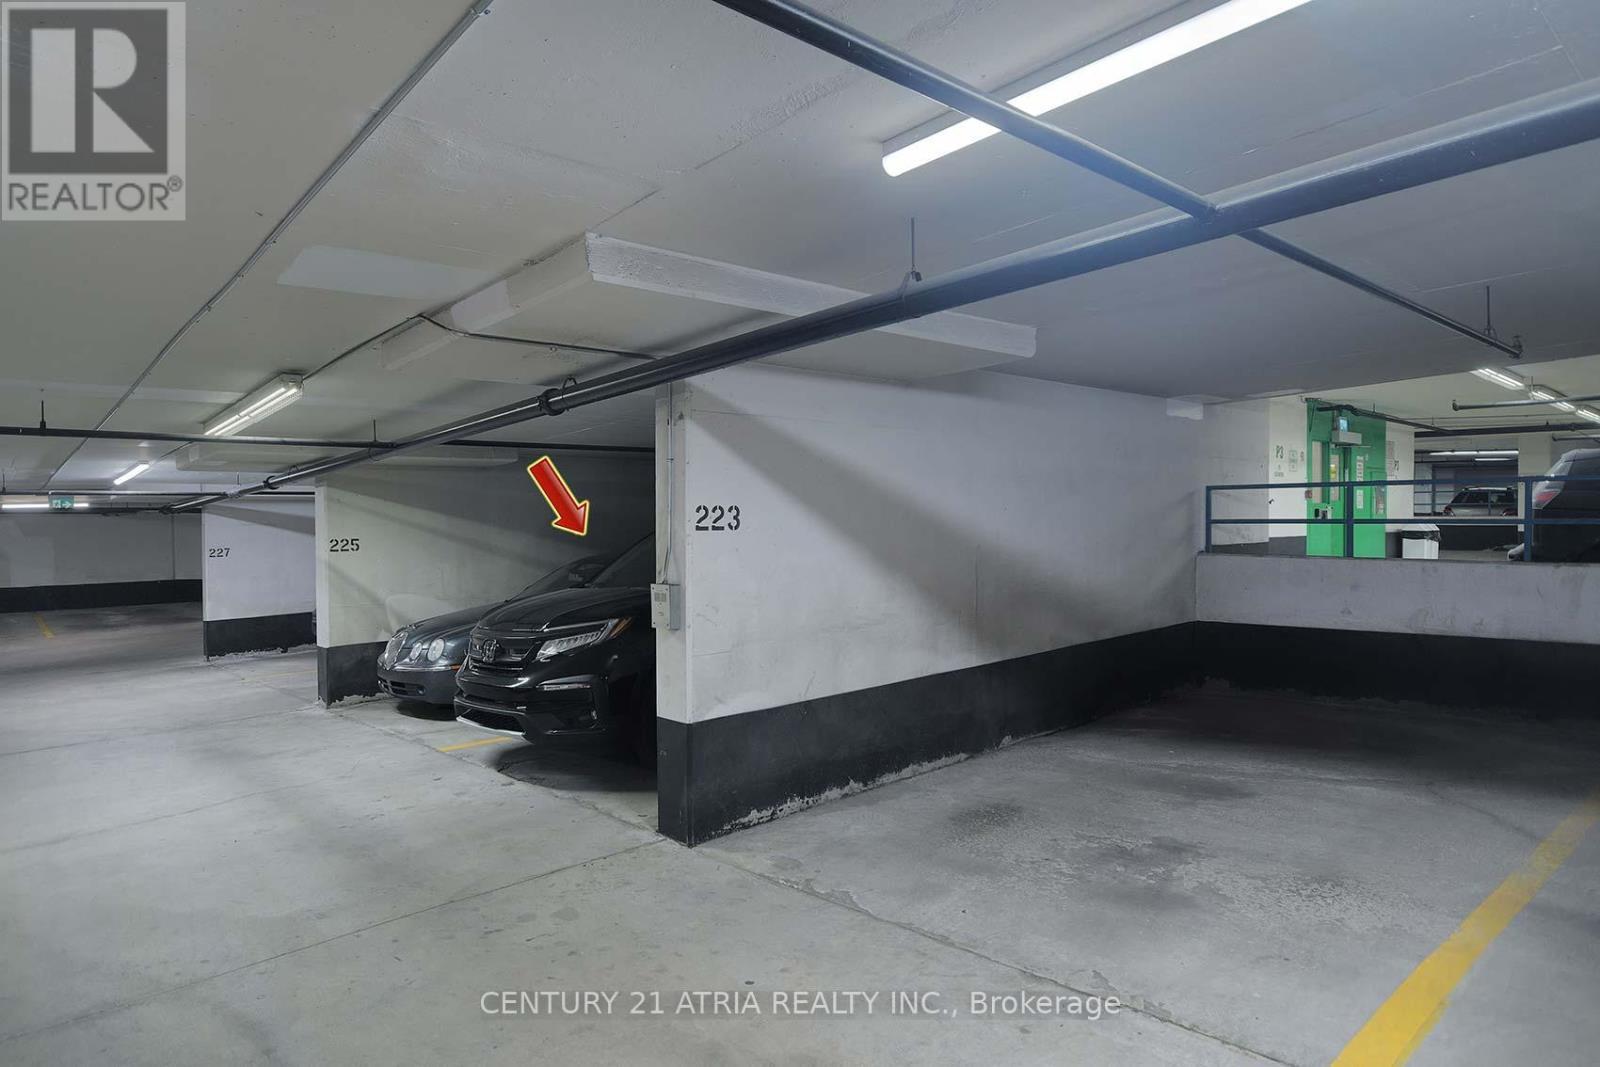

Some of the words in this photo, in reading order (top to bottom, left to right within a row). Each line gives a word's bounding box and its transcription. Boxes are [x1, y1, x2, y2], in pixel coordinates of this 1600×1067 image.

[695, 504, 741, 531] 223
[329, 538, 360, 552] 225
[209, 547, 231, 558] 227
